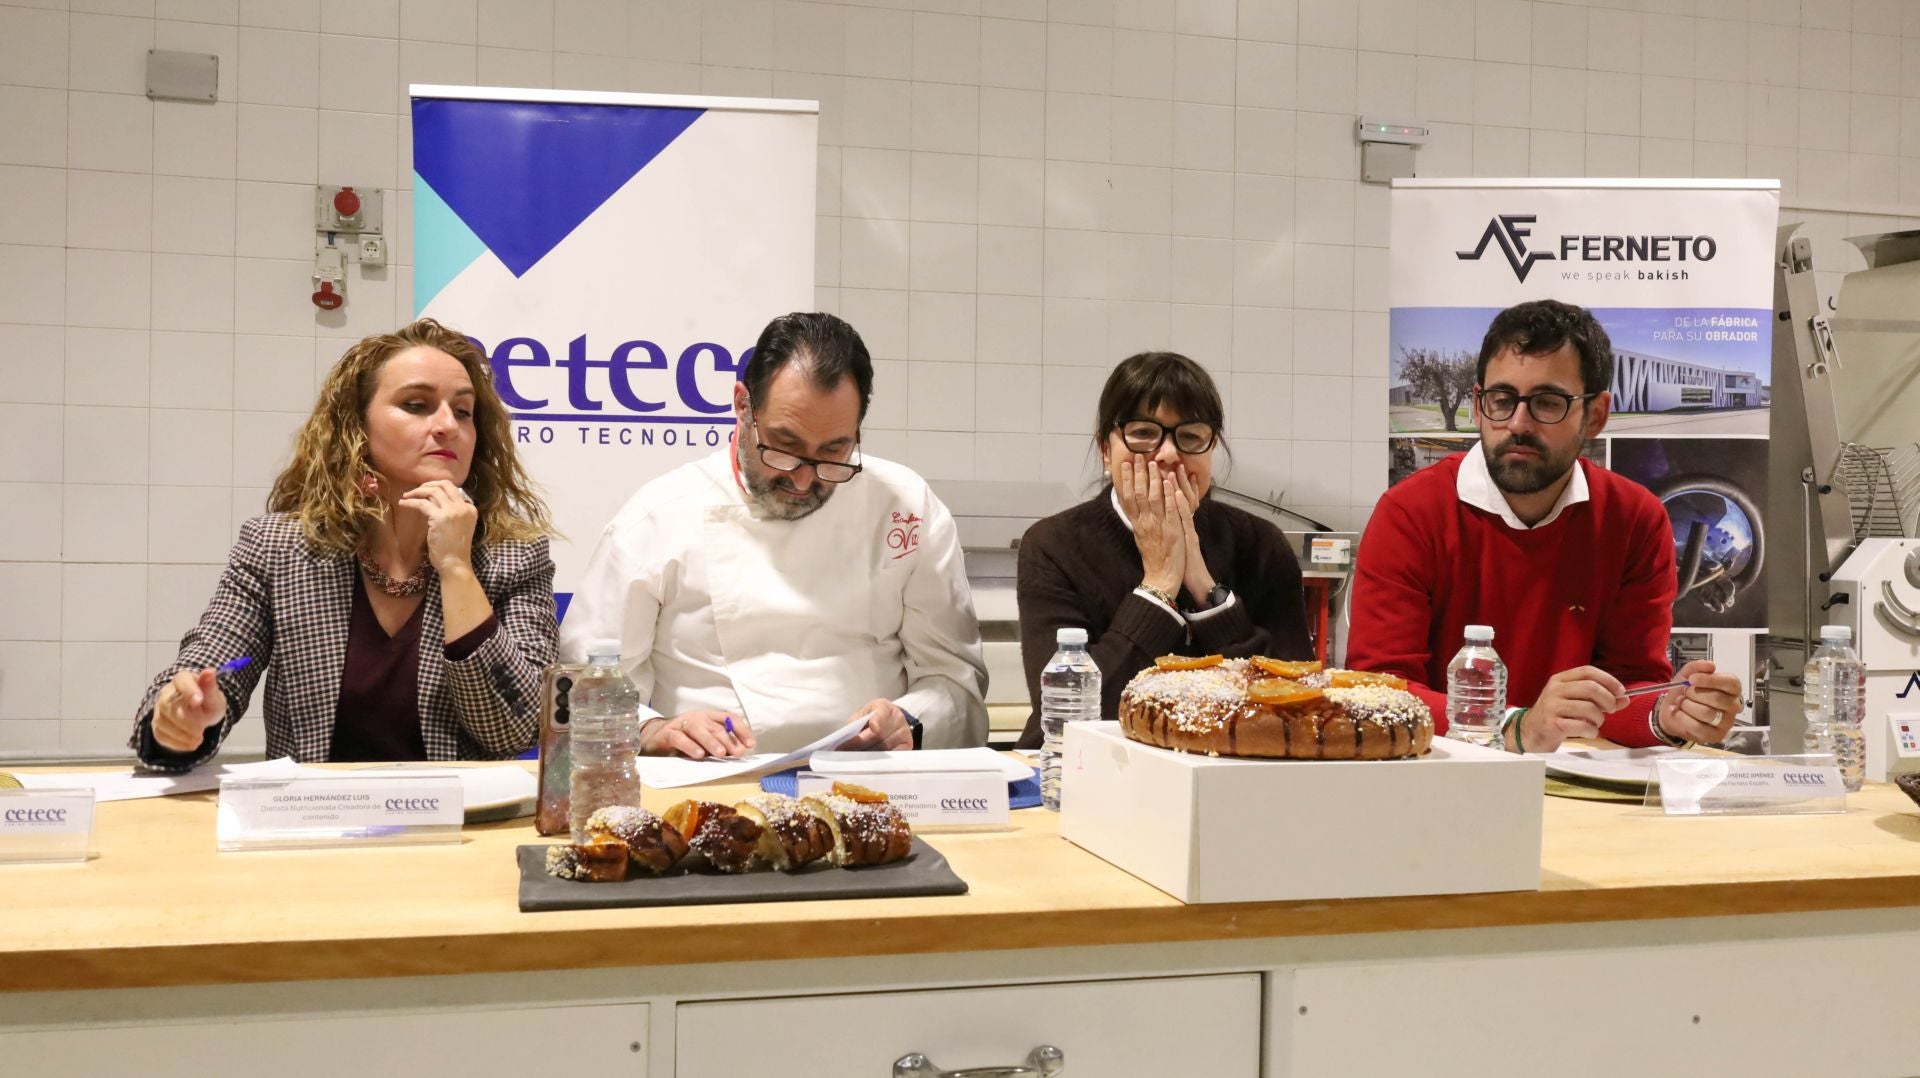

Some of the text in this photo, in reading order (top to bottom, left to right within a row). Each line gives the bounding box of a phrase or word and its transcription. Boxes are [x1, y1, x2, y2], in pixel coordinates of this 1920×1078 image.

[1560, 234, 1717, 262] FERNETO
[1561, 269, 1689, 283] we speak bakish
[1675, 315, 1758, 327] DE LA FÁBRICA
[1653, 331, 1758, 341] PARA SU OBRADOR
[465, 333, 756, 414] etec
[1784, 773, 1825, 783] cetece
[303, 794, 352, 802] HERNÁNDEZ
[385, 798, 439, 809] cetece
[941, 798, 988, 809] cetece
[290, 804, 336, 812] Nutricionista
[337, 803, 371, 811] Creadora
[5, 808, 67, 821] cetece
[302, 813, 339, 821] contenido
